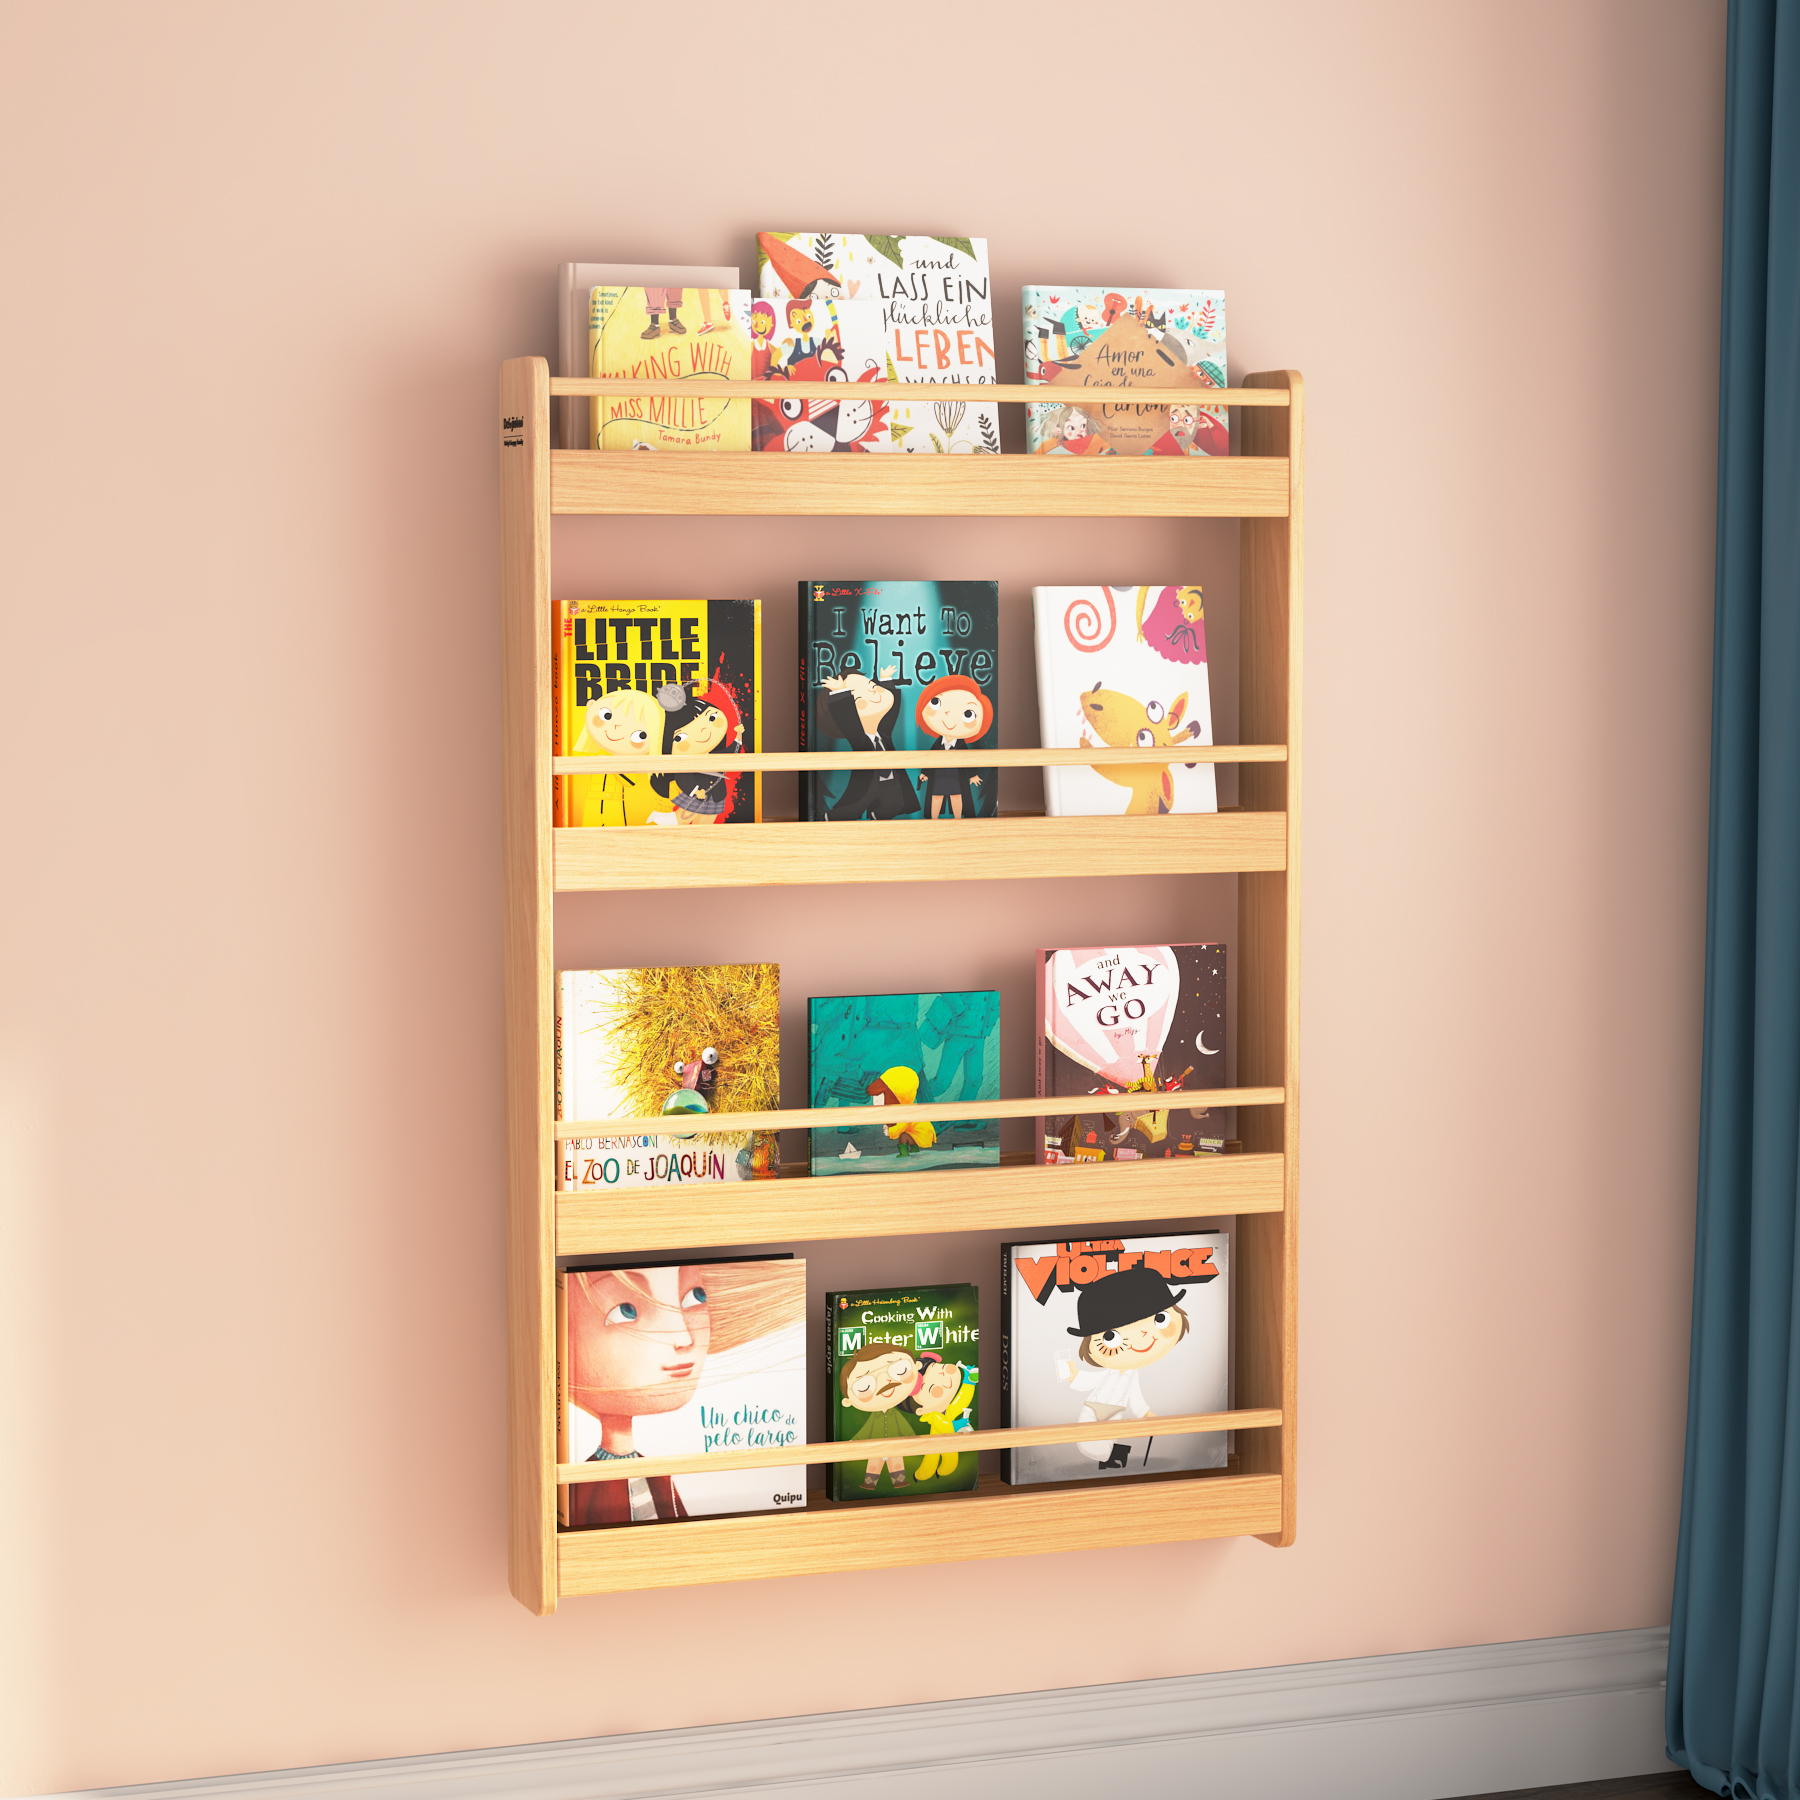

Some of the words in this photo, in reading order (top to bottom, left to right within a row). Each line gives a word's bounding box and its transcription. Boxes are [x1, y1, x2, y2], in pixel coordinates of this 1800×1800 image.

[910, 253, 960, 270] und
[877, 272, 929, 302] LASS
[883, 300, 993, 333] lückliche
[600, 346, 681, 379] KING
[690, 341, 732, 376] WITH
[894, 329, 996, 370] LEBEN
[1095, 343, 1145, 367] Amor
[1111, 367, 1127, 377] en
[1130, 367, 1157, 378] una
[610, 397, 643, 419] MISS
[649, 396, 708, 428] MILLIE
[658, 429, 692, 445] Tamara
[695, 430, 722, 444] Bundy
[831, 587, 853, 597] Little
[587, 604, 609, 613] Little
[832, 608, 846, 636] I
[861, 606, 927, 636] Want
[941, 607, 972, 636] To
[563, 617, 573, 638] THE
[574, 618, 701, 661] LITTLE
[812, 638, 993, 687] Believe
[574, 662, 702, 707] BRIDE
[1096, 953, 1121, 970] and
[1066, 963, 1162, 1008] AWAY
[1108, 991, 1127, 1003] we
[1096, 998, 1146, 1027] GO
[565, 1138, 593, 1150] PABLO
[598, 1135, 658, 1150] BERNASCONI
[565, 1160, 578, 1181] EL
[626, 1158, 641, 1175] DE
[644, 1150, 725, 1182] JOAQUÍN
[1014, 1246, 1220, 1301] VIOLENCE
[861, 1310, 915, 1324] Cooking
[916, 1306, 953, 1321] With
[917, 1325, 980, 1346] White
[700, 1405, 729, 1429] Un
[733, 1404, 785, 1426] chico
[785, 1414, 798, 1426] de
[704, 1427, 744, 1453] pelo
[747, 1427, 798, 1447] largo
[772, 1492, 803, 1505] Quipu
